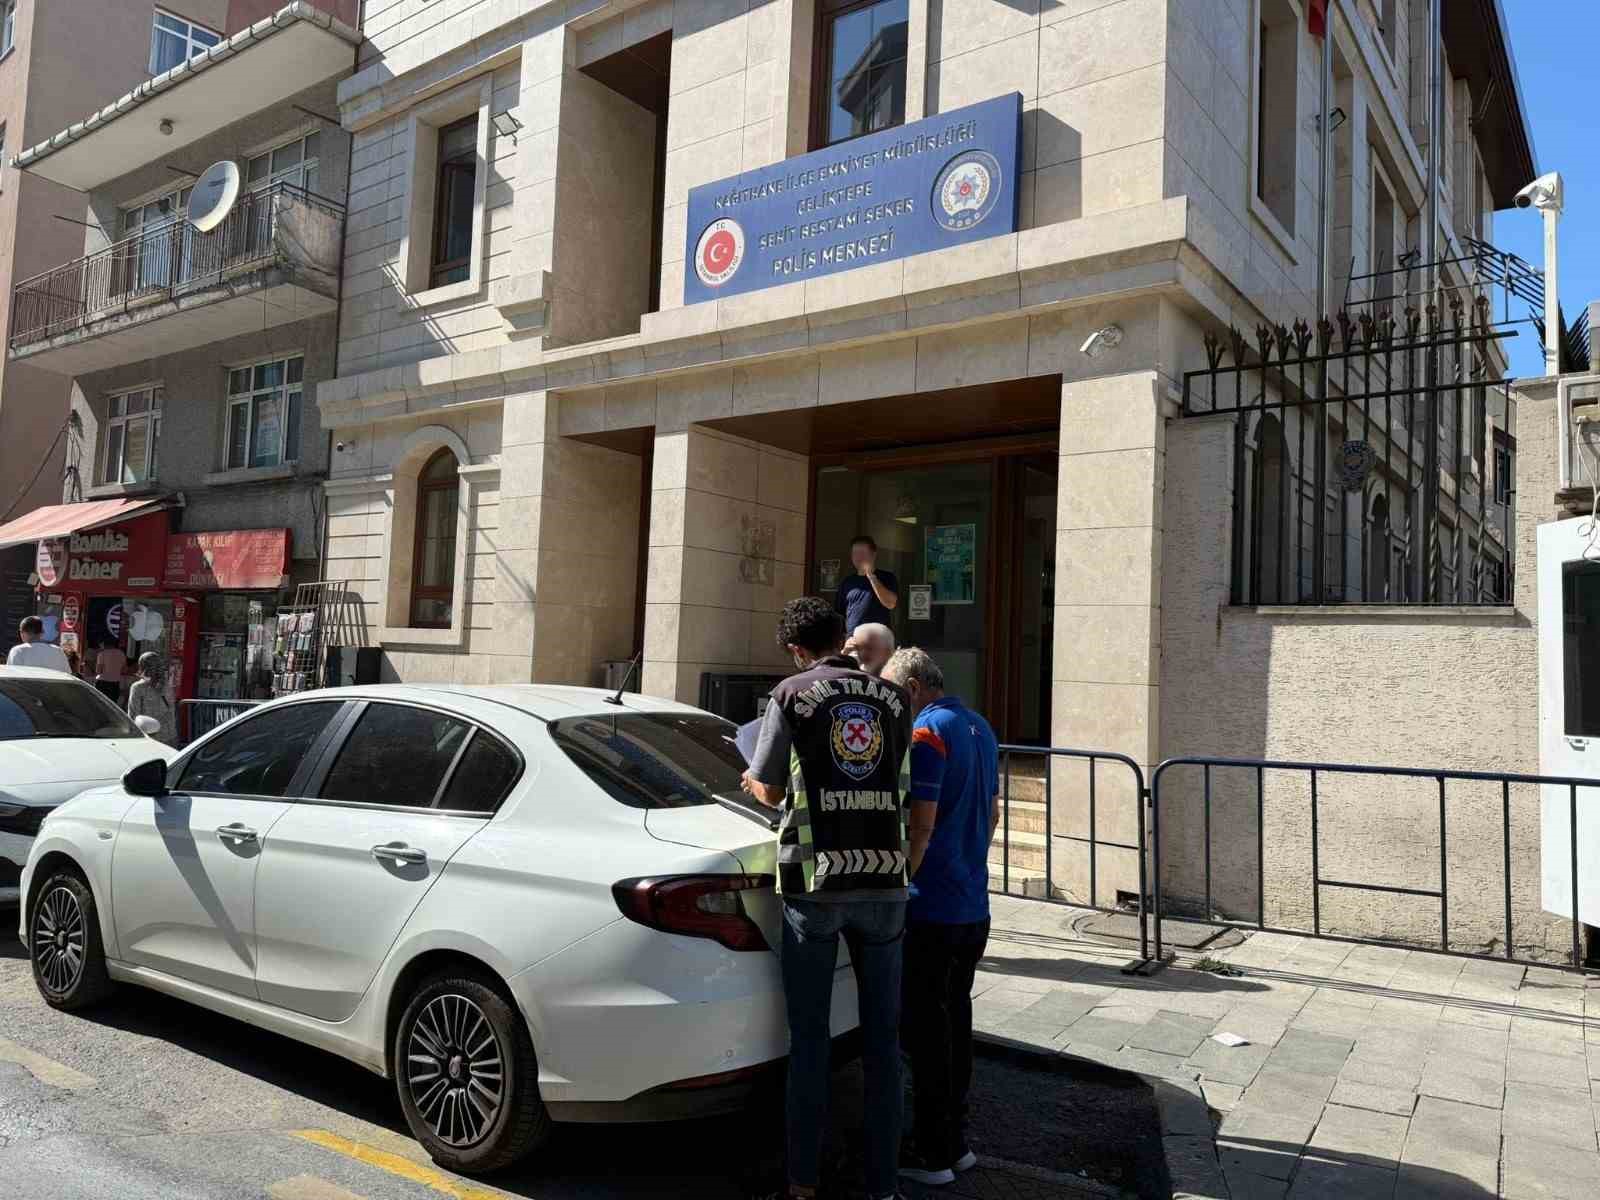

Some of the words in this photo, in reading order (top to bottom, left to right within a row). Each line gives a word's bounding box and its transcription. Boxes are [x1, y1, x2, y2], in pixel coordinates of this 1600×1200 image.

[817, 149, 880, 182] EMNİYET
[772, 246, 817, 278] POLİS
[820, 224, 896, 265] MERKEZİ
[69, 556, 124, 580] Döner
[837, 678, 904, 718] TRAFİK
[819, 787, 897, 812] İSTANBUL
